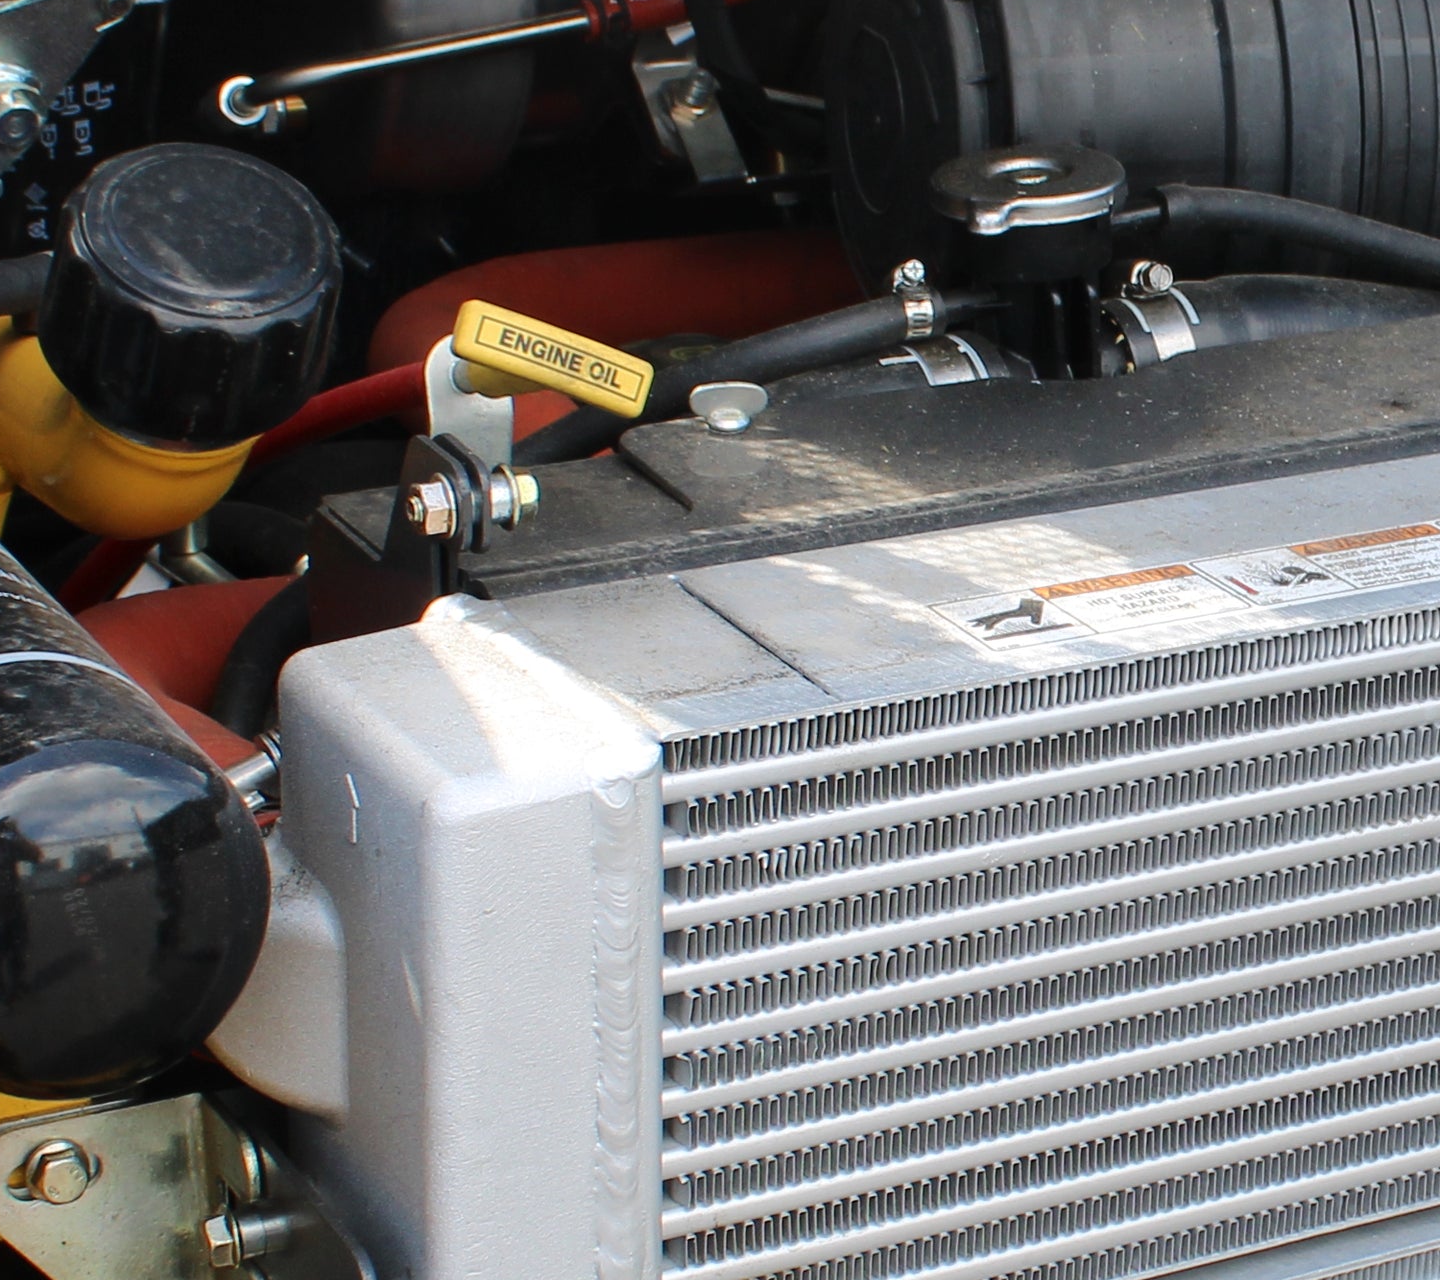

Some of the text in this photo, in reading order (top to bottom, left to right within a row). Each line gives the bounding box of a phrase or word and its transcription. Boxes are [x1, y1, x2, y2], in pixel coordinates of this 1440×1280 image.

[499, 327, 621, 390] ENGINE OIL
[1070, 566, 1192, 595] WARNING
[1087, 584, 1187, 608] HOT SURFACE
[1117, 596, 1181, 612] HAZARD
